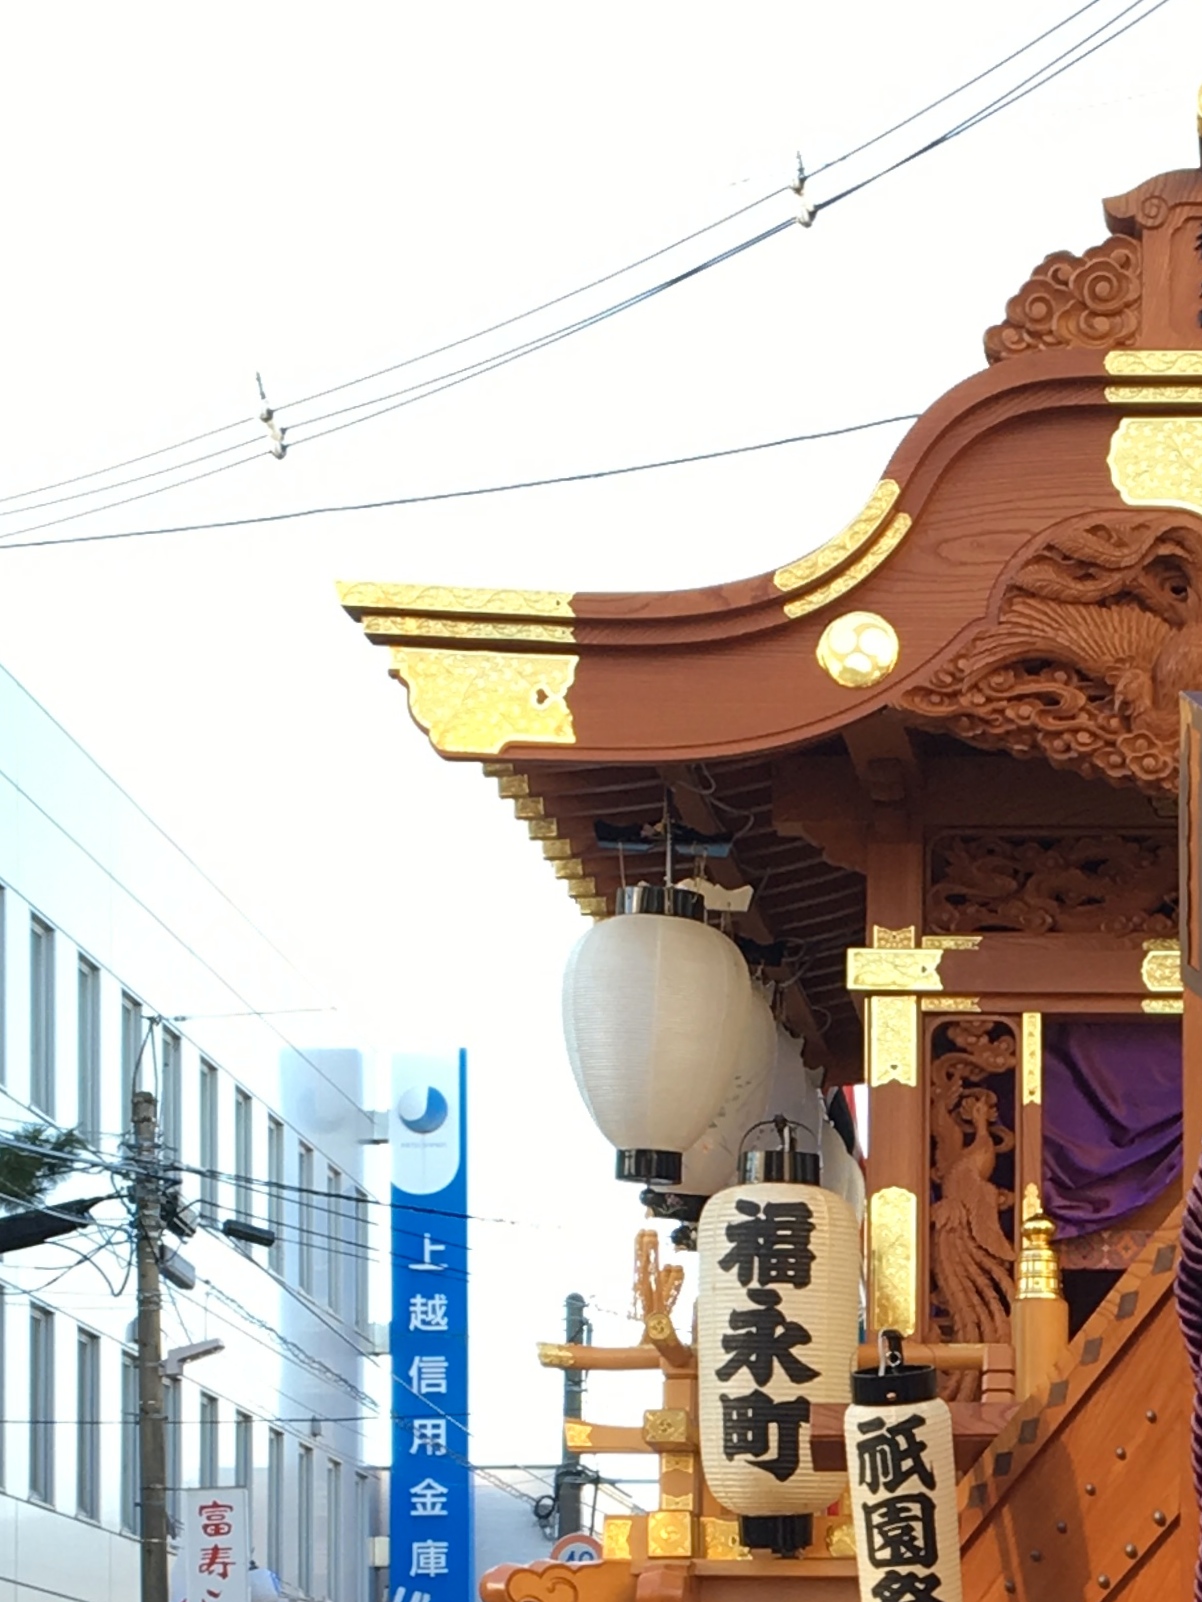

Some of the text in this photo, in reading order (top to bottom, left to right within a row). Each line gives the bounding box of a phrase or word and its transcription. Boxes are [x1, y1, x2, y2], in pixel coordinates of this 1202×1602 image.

[408, 1233, 449, 1578] 上越信用金庫
[715, 1199, 822, 1482] 福永町
